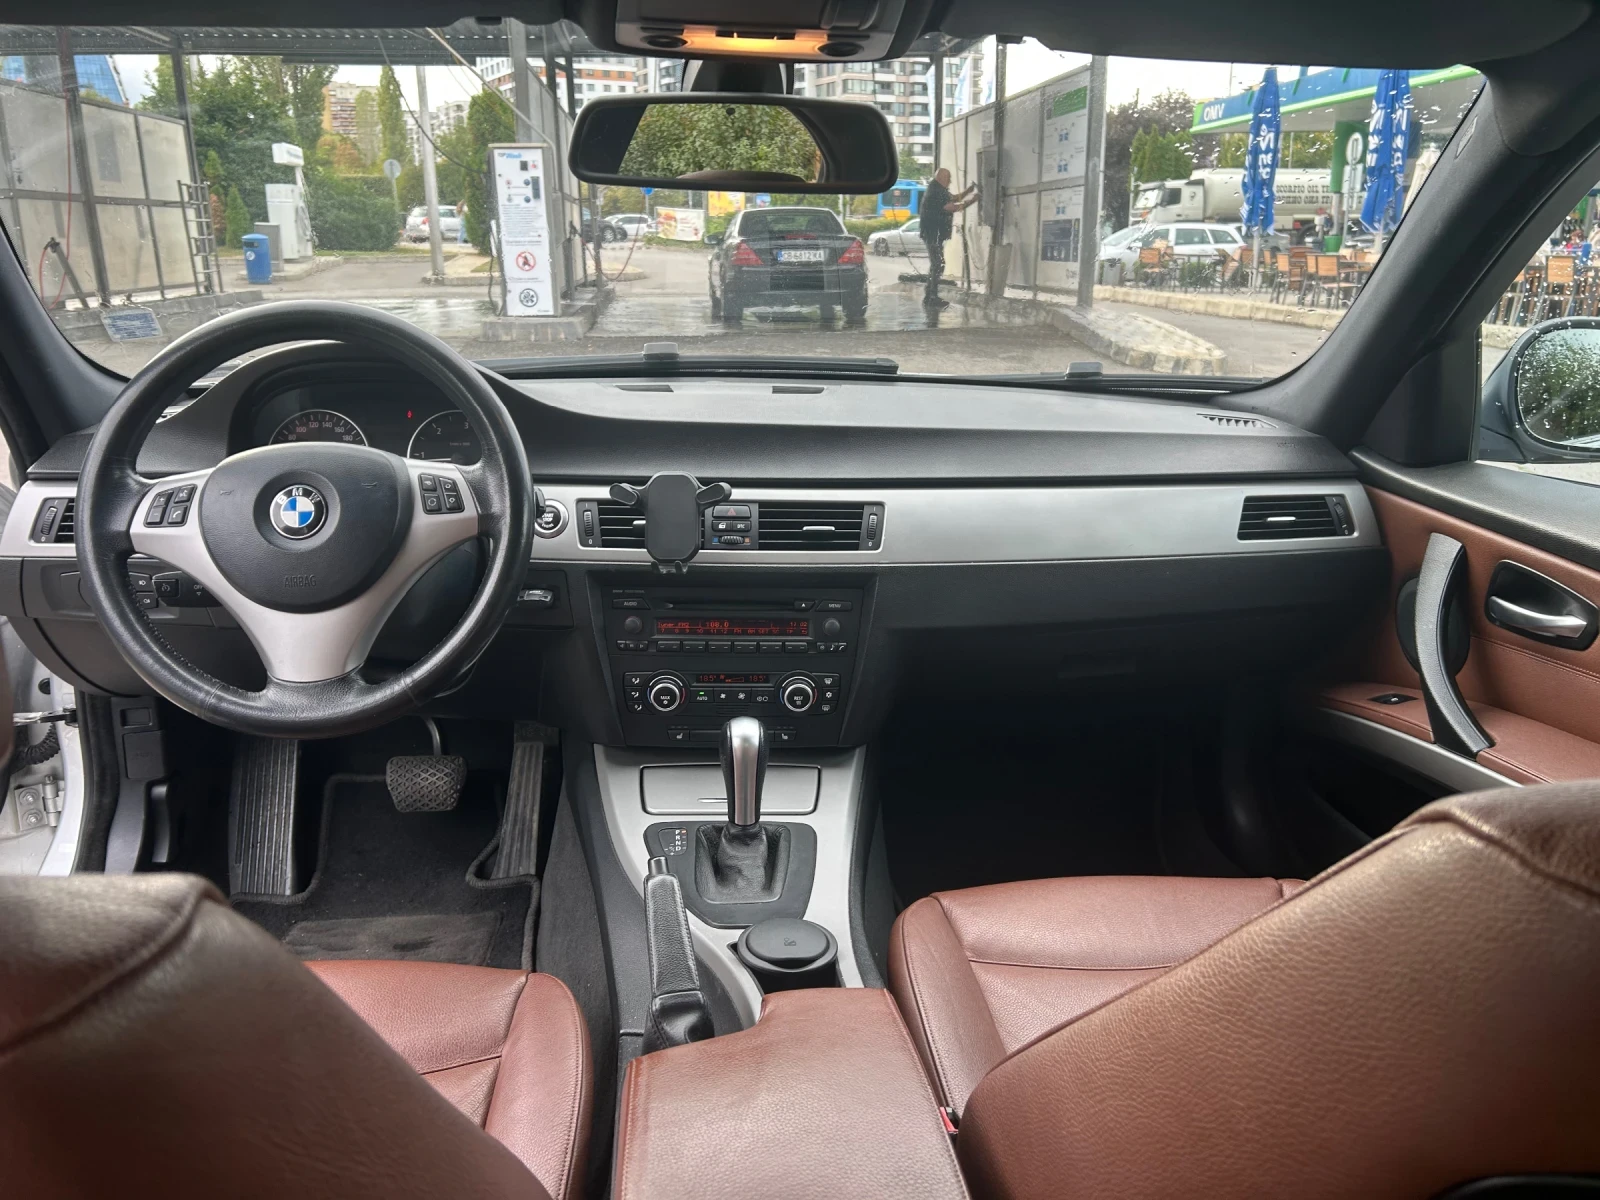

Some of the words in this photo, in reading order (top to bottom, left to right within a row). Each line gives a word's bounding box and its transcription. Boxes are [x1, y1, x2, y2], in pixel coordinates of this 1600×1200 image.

[1203, 103, 1225, 122] OMV
[1276, 184, 1305, 194] SCORPIO
[1307, 185, 1319, 194] OIL
[436, 427, 442, 435] 2
[276, 487, 321, 505] BMW
[284, 575, 317, 588] AIRBAG
